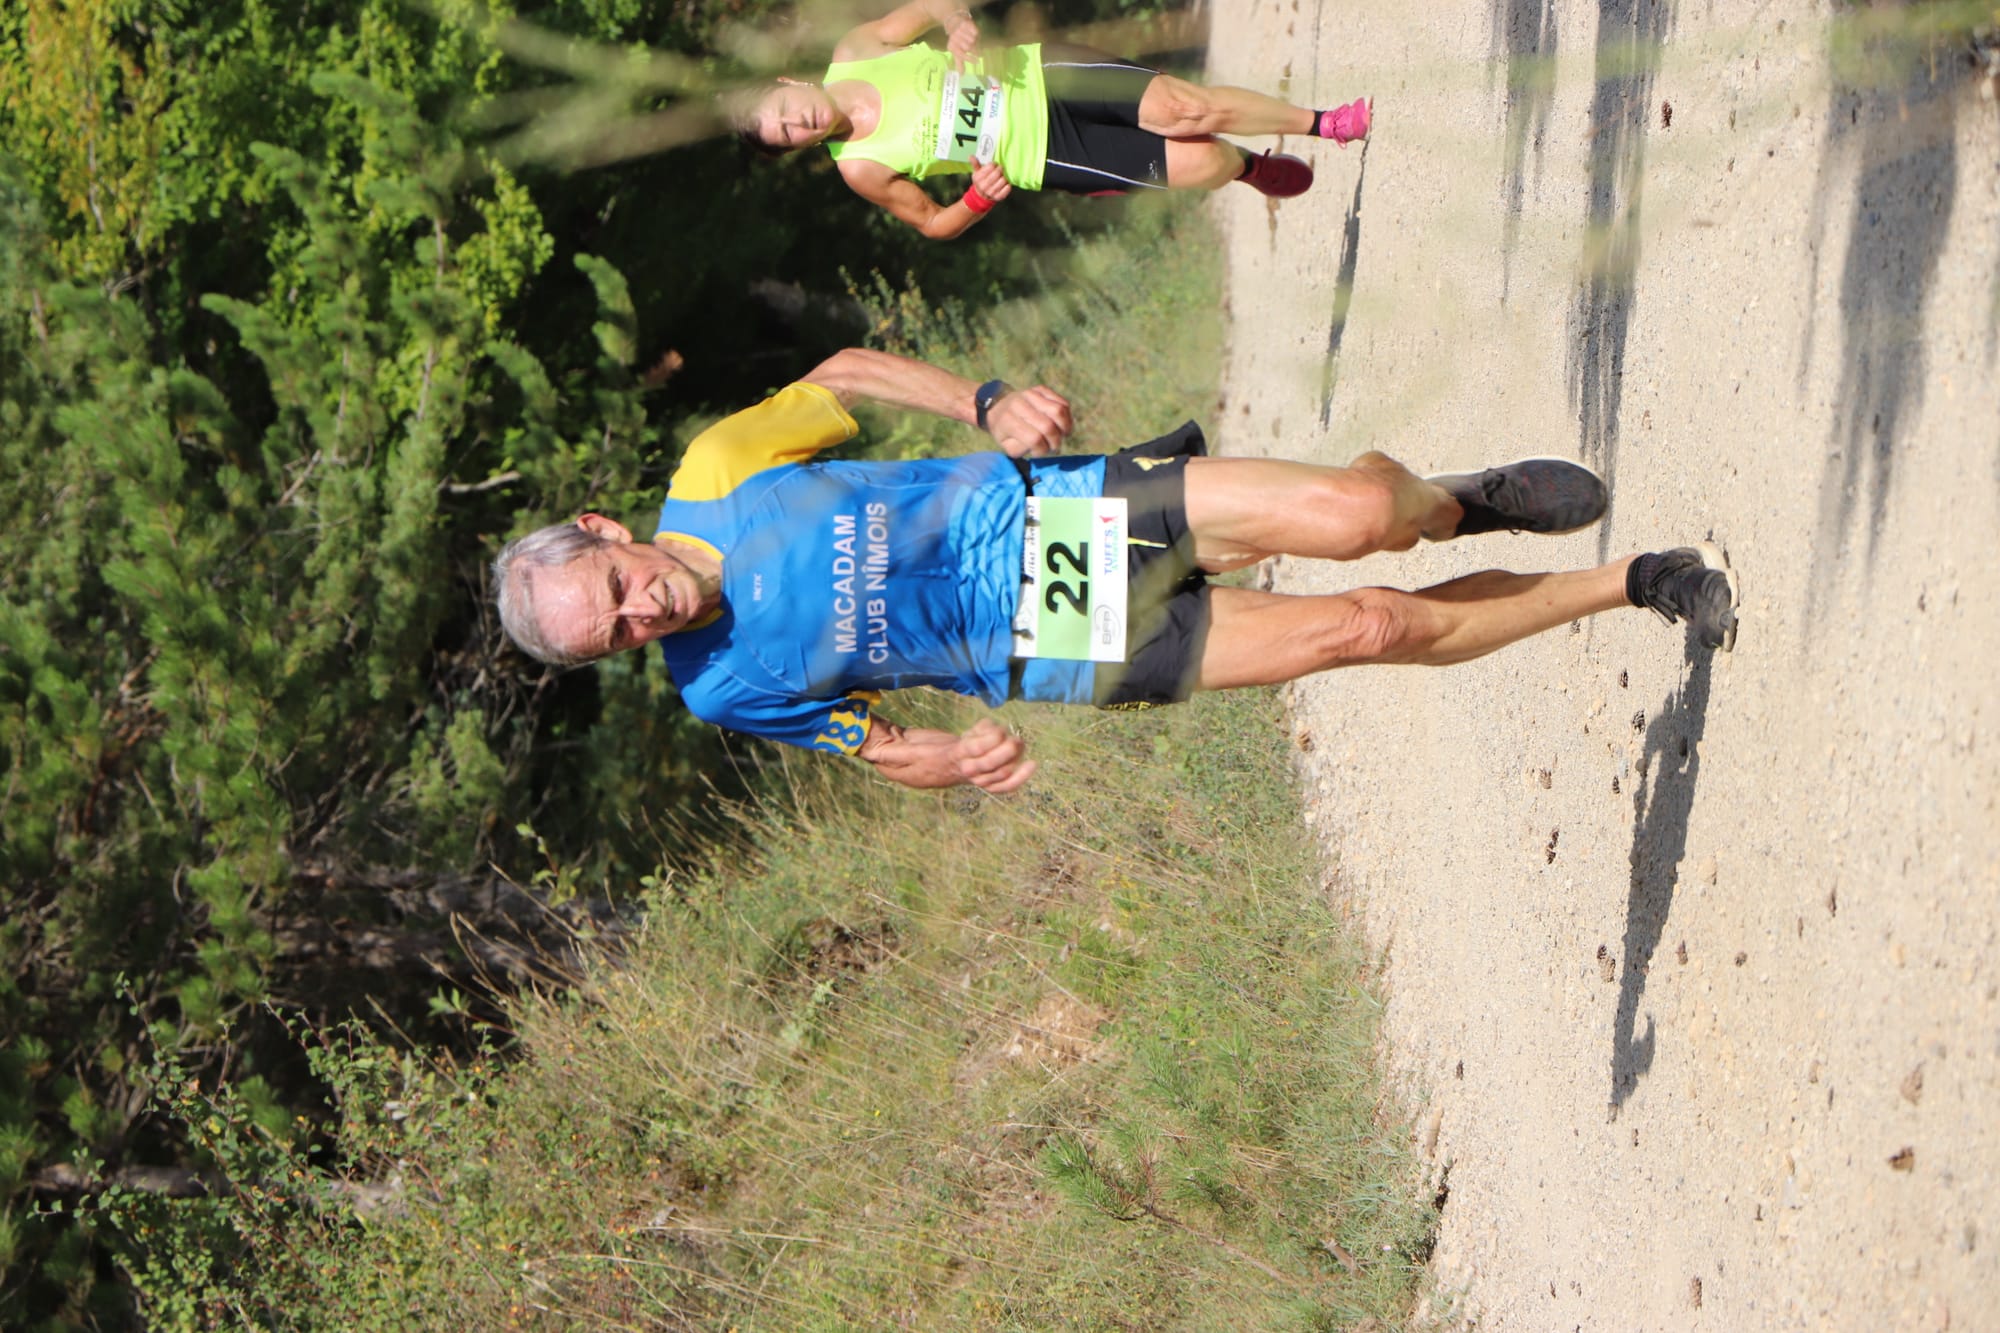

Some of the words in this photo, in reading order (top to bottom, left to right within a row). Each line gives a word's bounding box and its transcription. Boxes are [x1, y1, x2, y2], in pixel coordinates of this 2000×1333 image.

[955, 86, 985, 148] 144
[833, 515, 857, 653] MACADAM
[861, 502, 889, 591] NÎMOIS
[1045, 541, 1089, 617] 22
[865, 598, 889, 664] CLUB
